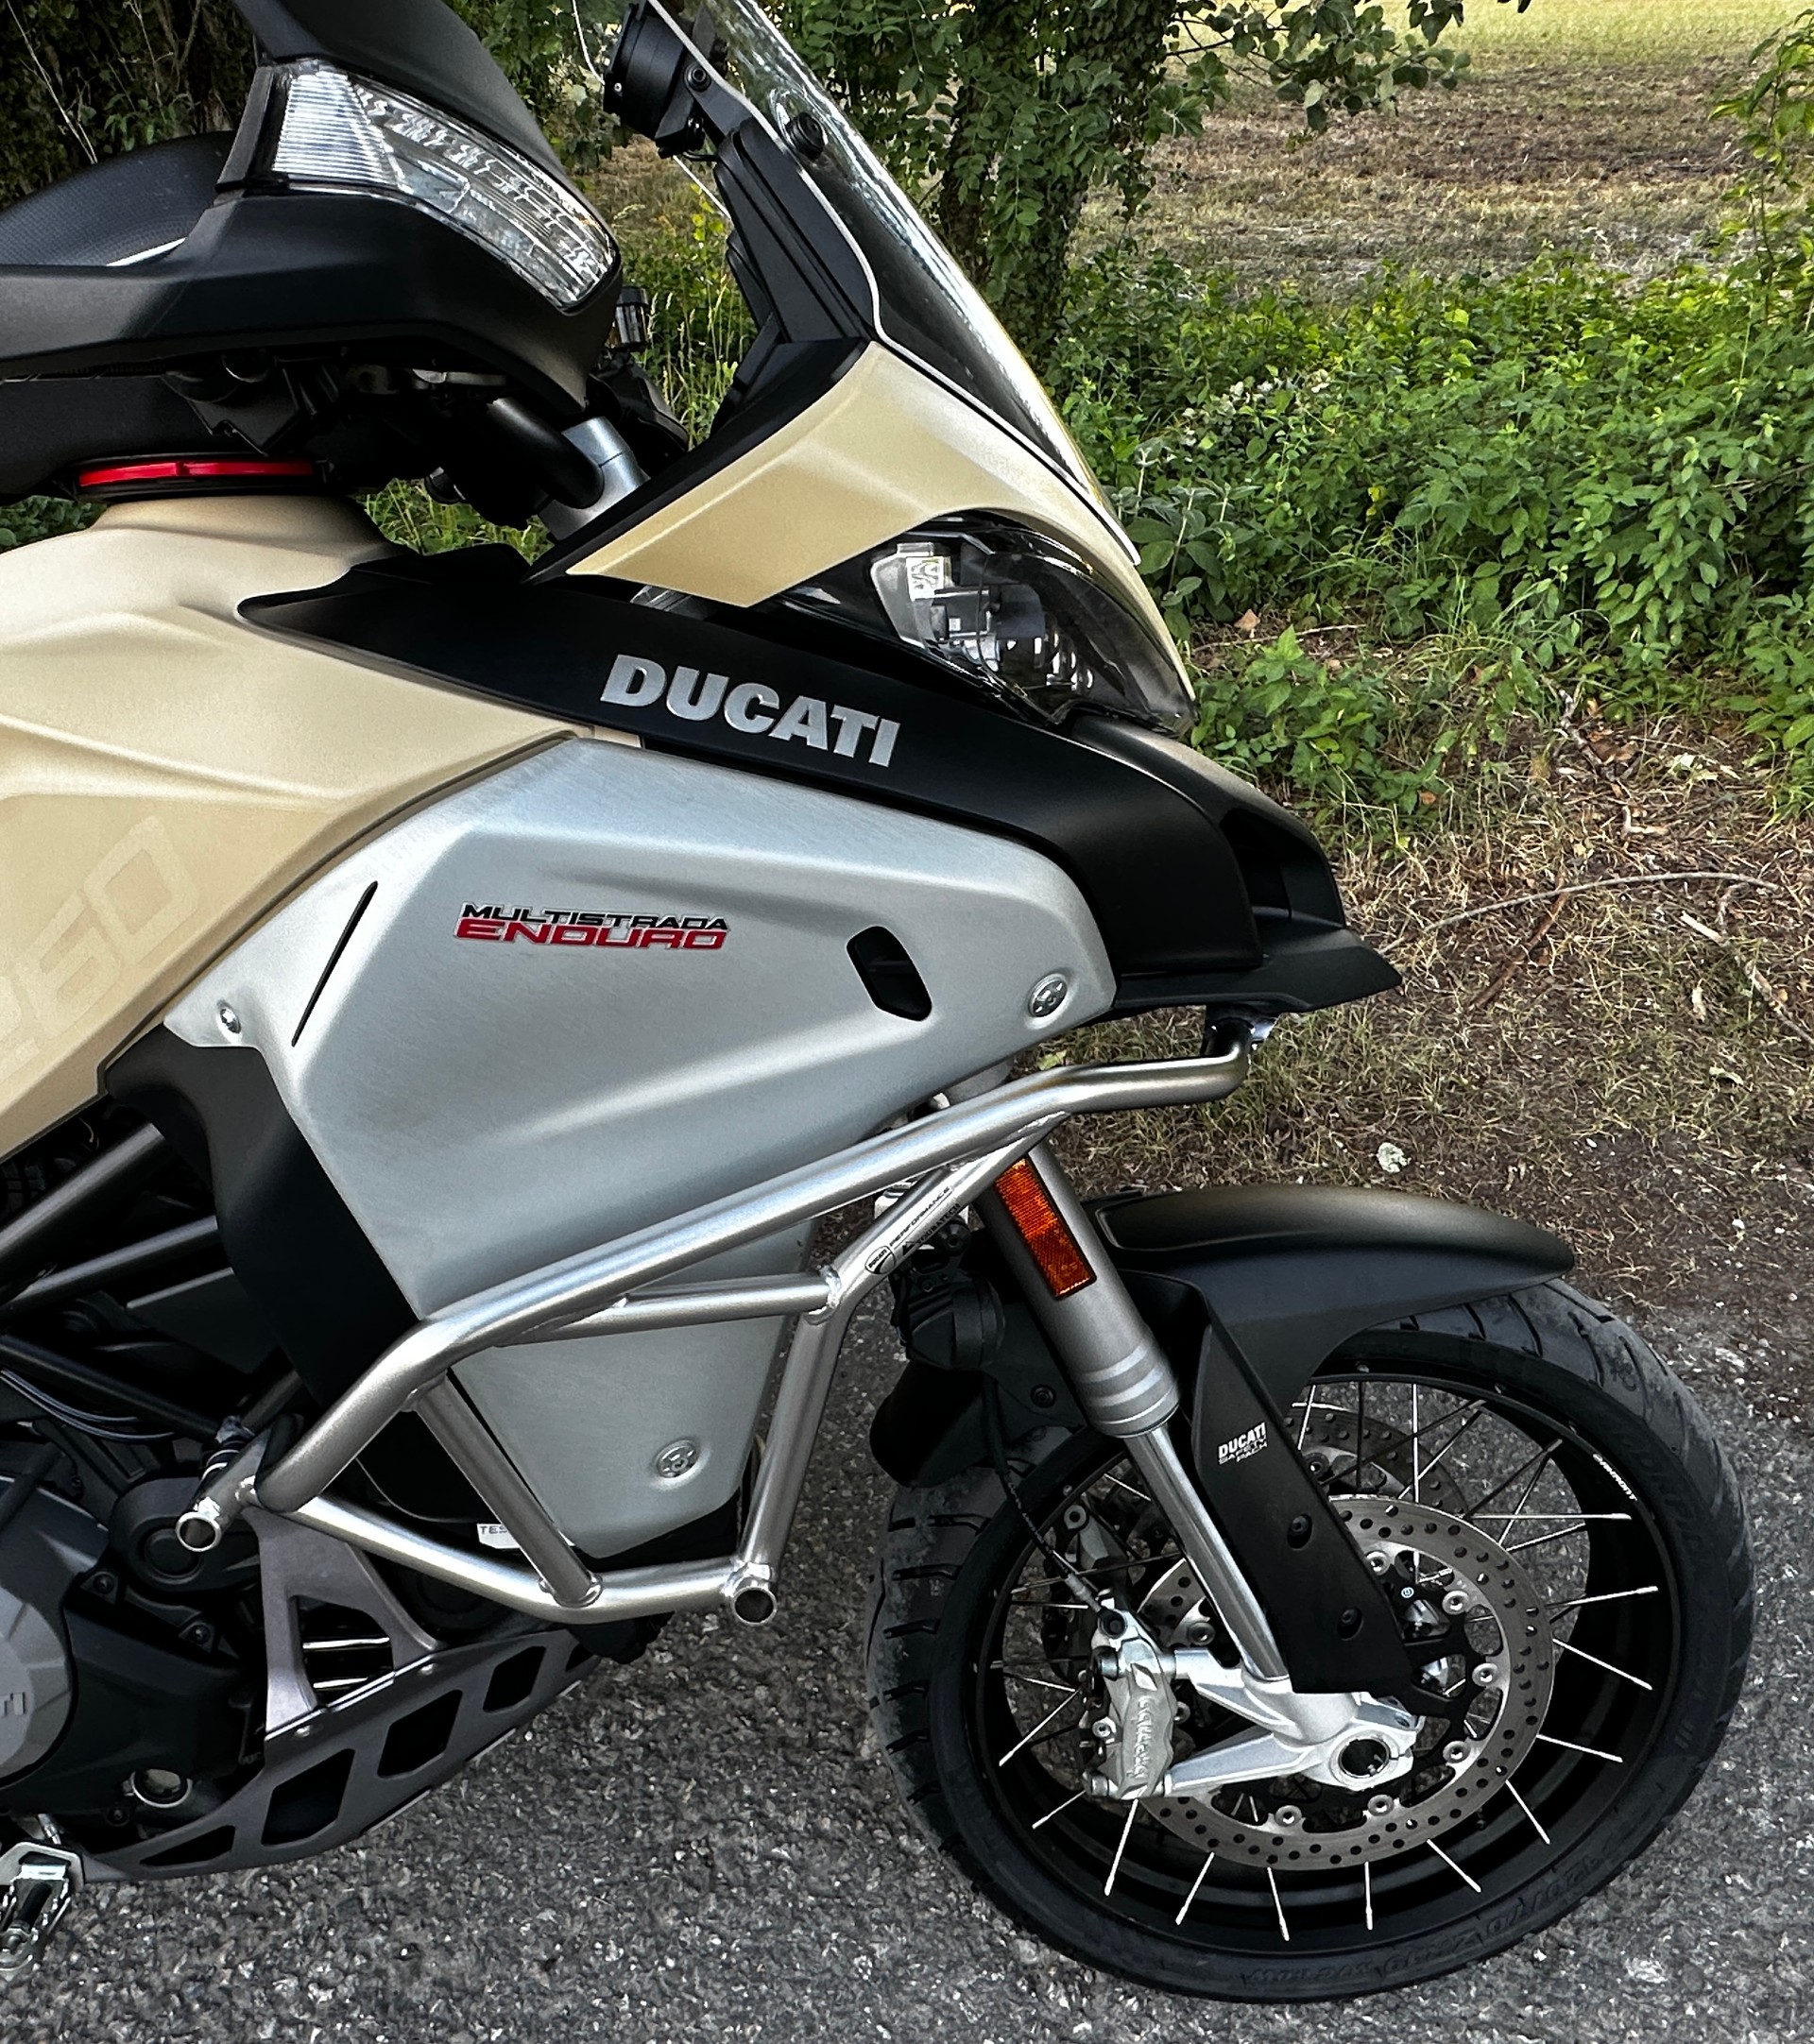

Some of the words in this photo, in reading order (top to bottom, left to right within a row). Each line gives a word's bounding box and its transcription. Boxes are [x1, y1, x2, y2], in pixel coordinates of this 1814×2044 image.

[600, 654, 900, 768] DUCATI
[455, 918, 728, 949] ENDURO
[461, 904, 728, 930] MULTISTRADA
[889, 1186, 950, 1247] PERFORMANCE
[1218, 1422, 1267, 1460] DUCATI
[1126, 1695, 1153, 1780] brembo
